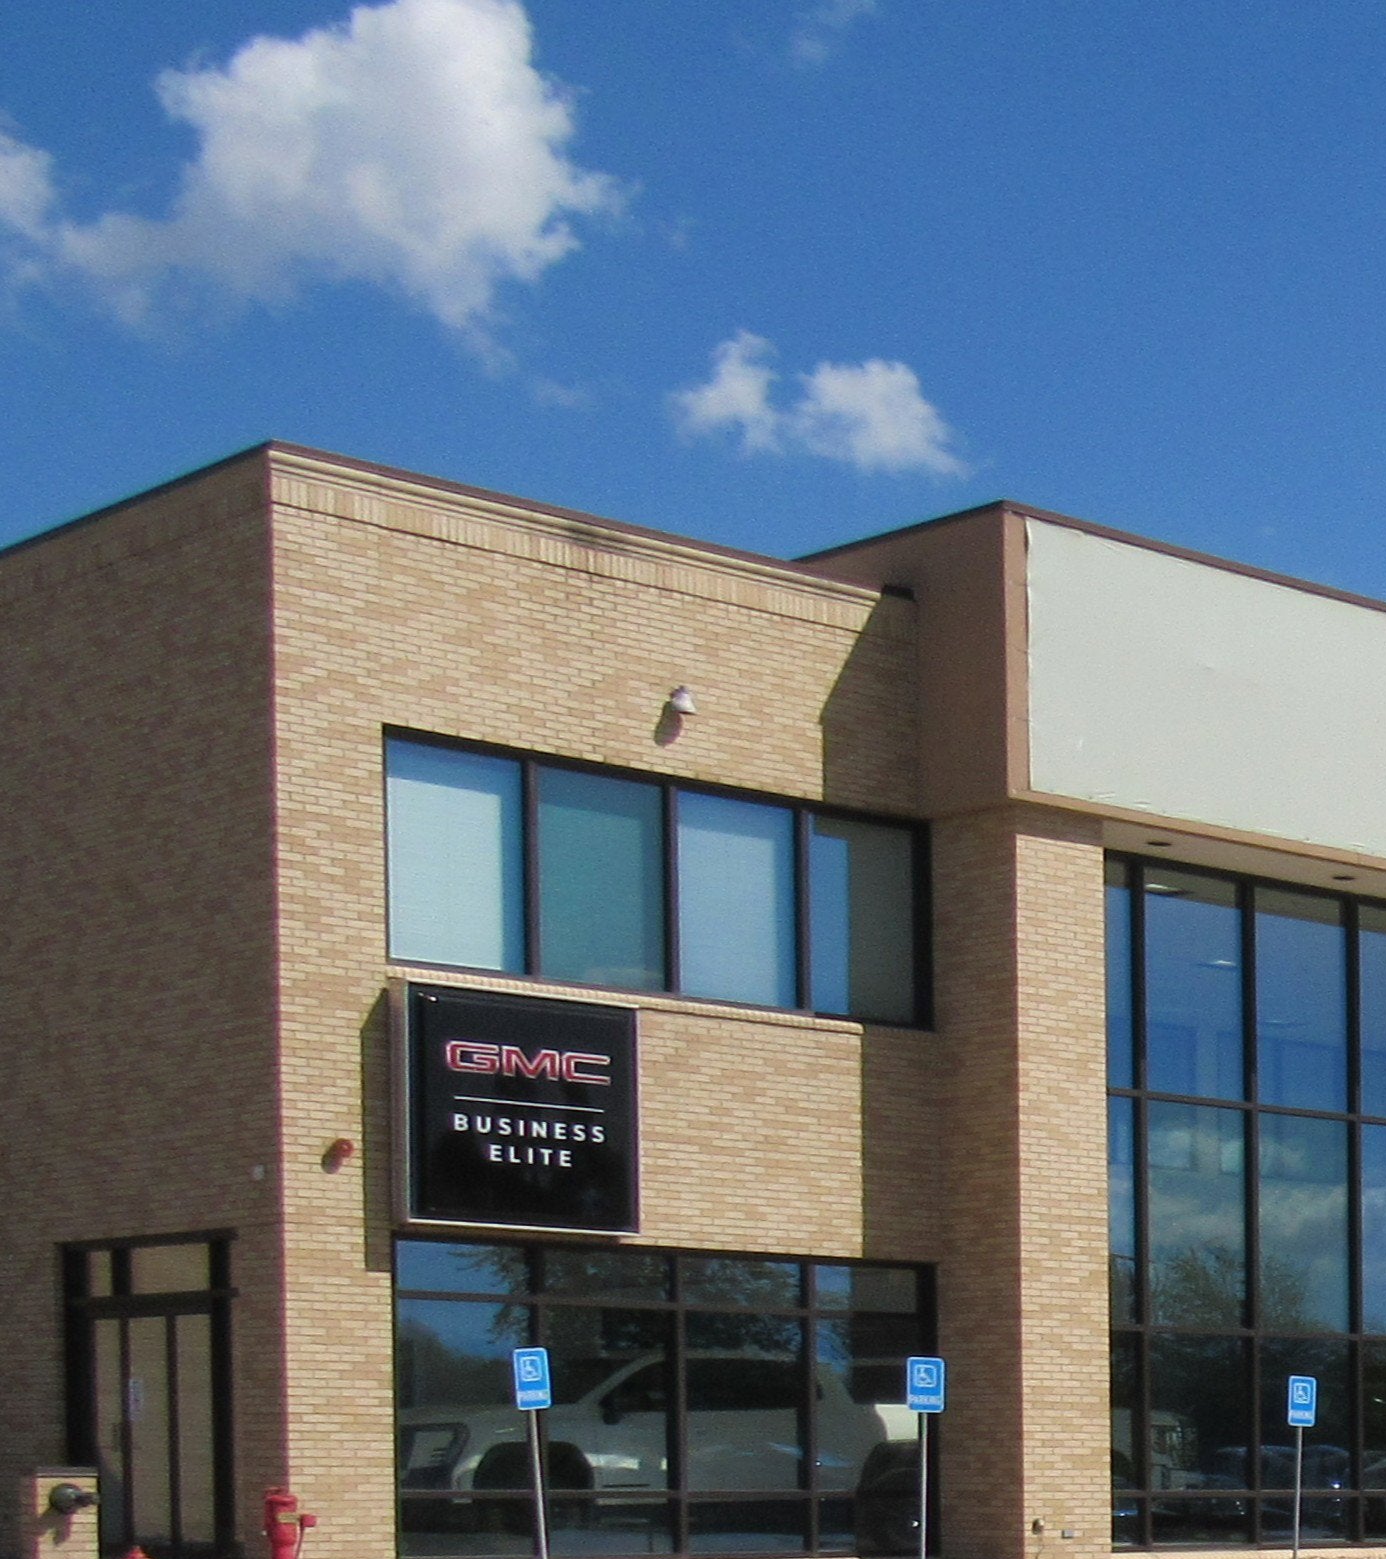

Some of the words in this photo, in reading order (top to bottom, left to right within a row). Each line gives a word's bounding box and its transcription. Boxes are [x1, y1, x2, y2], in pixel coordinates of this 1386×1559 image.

[446, 1040, 612, 1086] GMC
[453, 1113, 606, 1144] BUSINESS
[489, 1144, 573, 1168] ELITE
